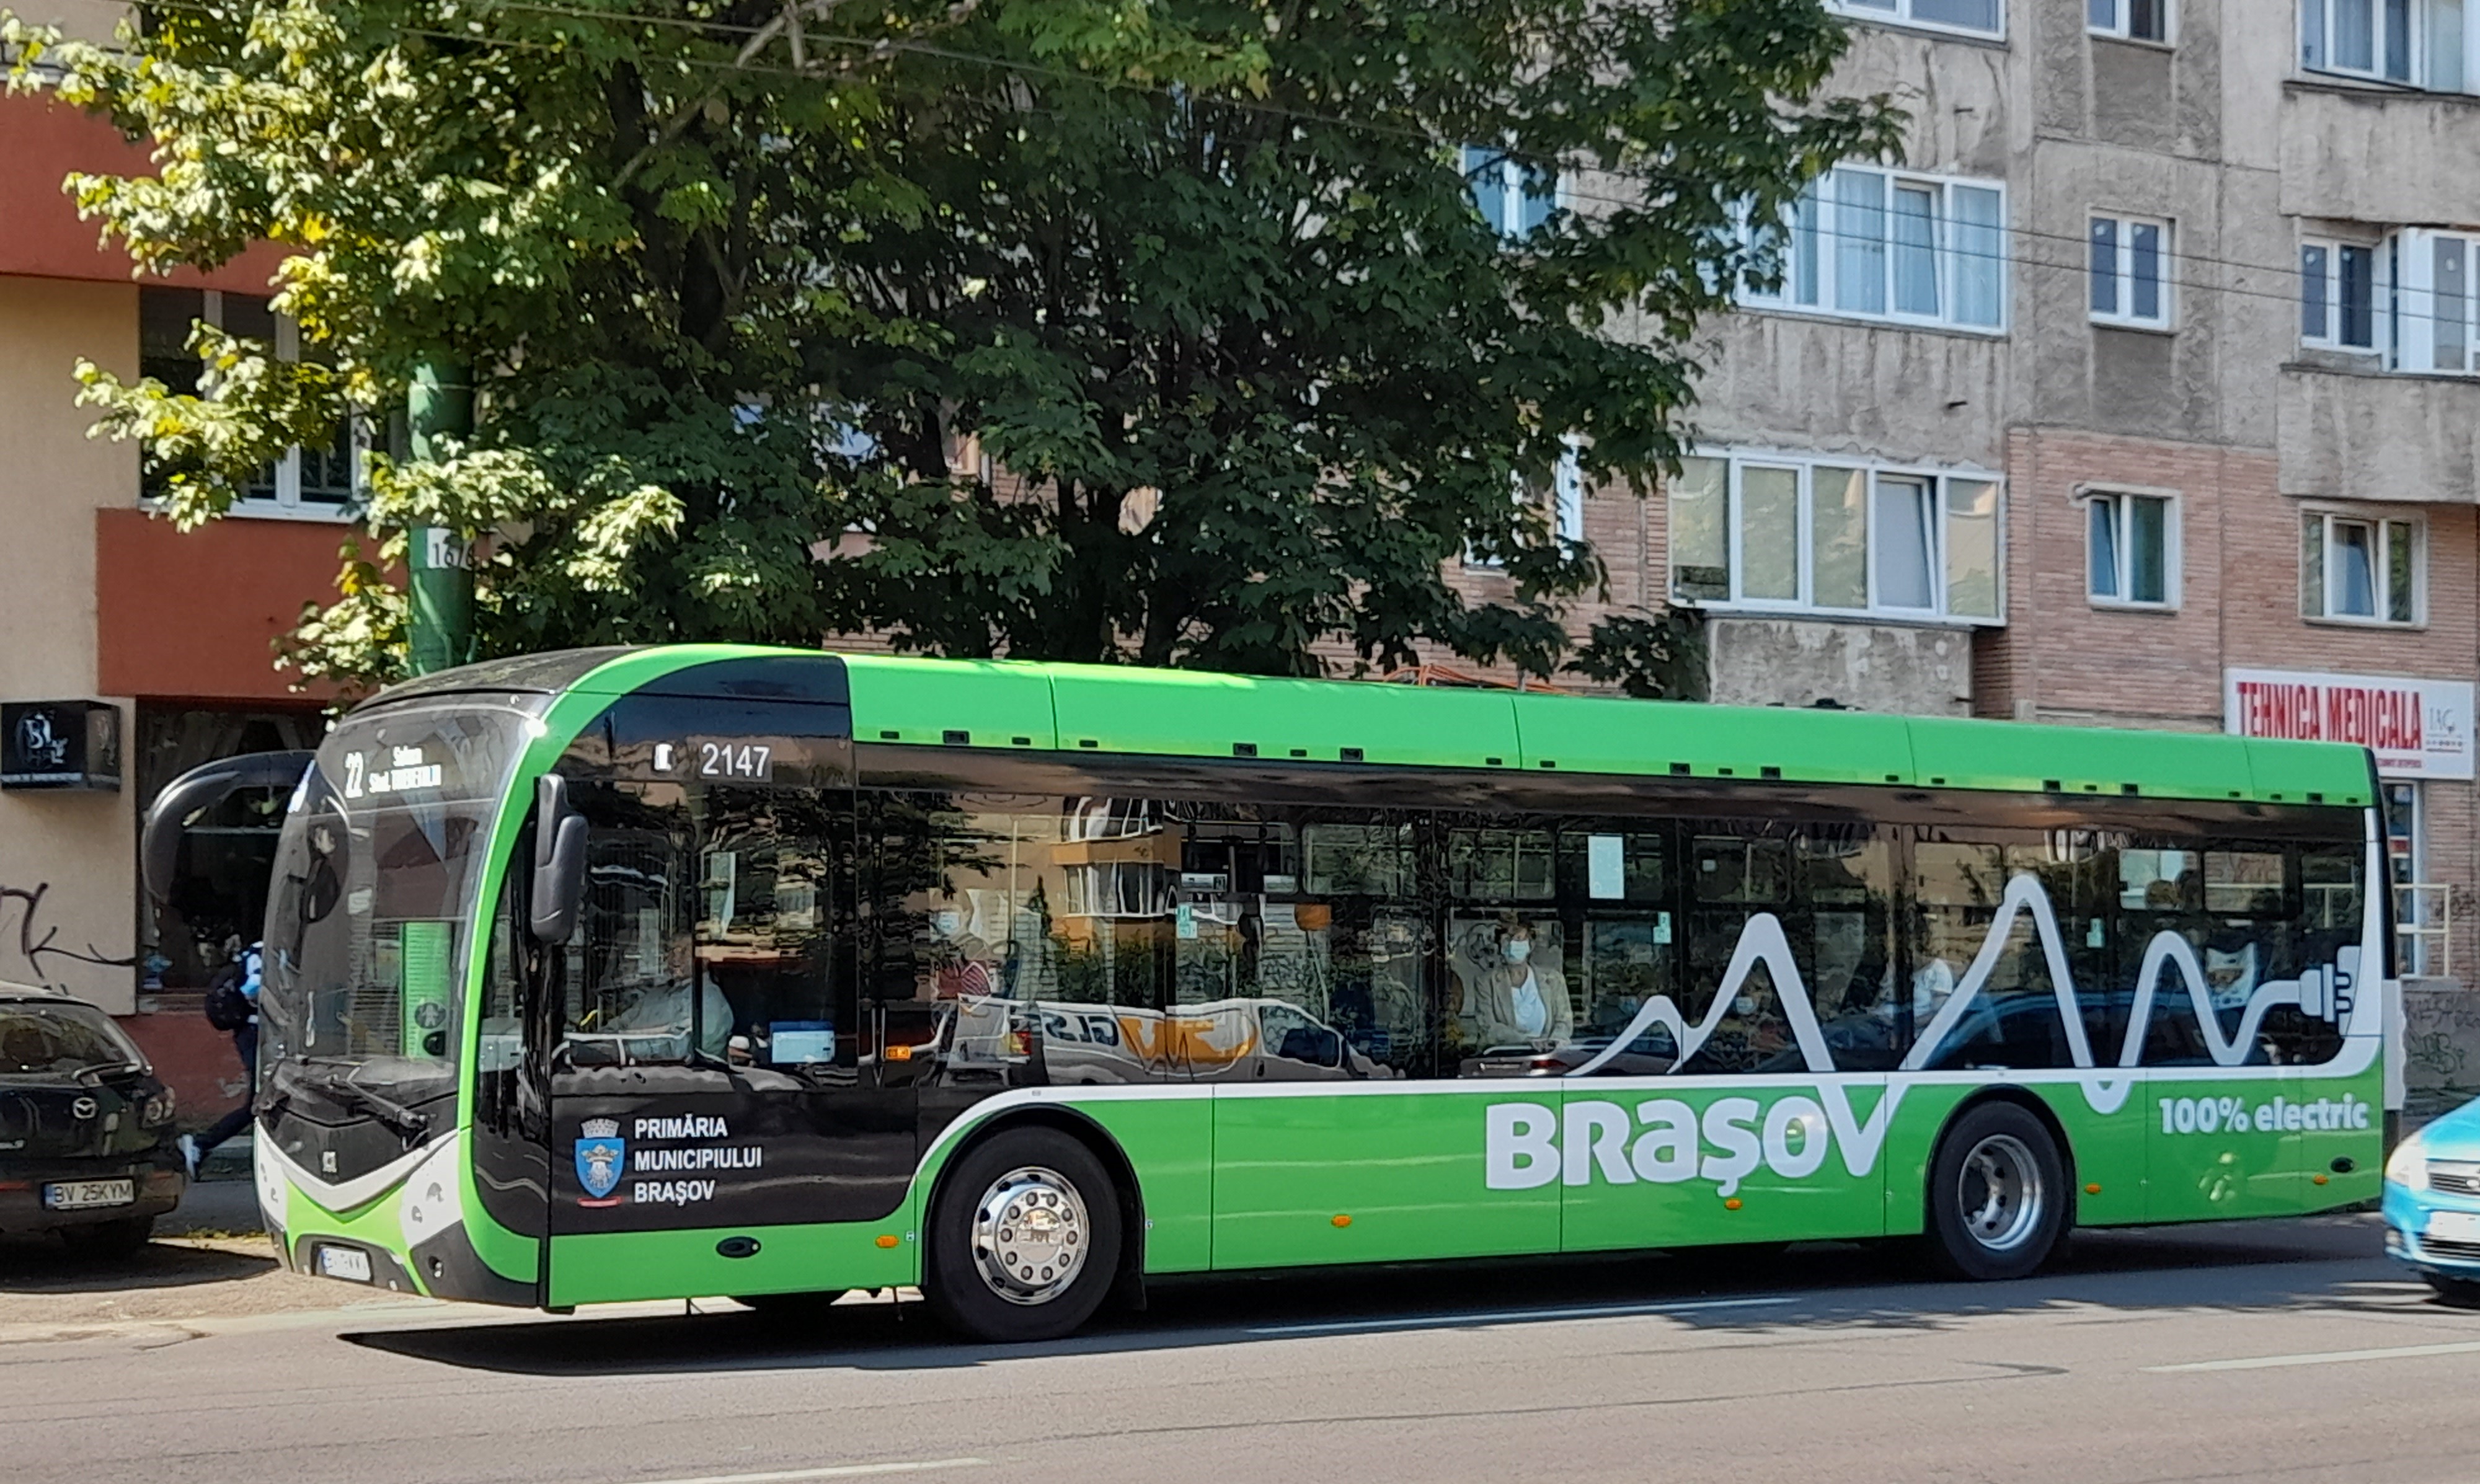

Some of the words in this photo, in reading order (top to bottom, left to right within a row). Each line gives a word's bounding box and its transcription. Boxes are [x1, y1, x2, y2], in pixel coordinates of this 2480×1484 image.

[2237, 682, 2321, 740] TEHNICA
[2327, 686, 2422, 749] MEDICALA
[702, 743, 770, 777] 2147
[635, 1113, 728, 1139] PRIMĂRIA
[2159, 1096, 2249, 1134] 100%
[2254, 1092, 2369, 1132] electric
[635, 1147, 762, 1171] MUNICIPIULUI
